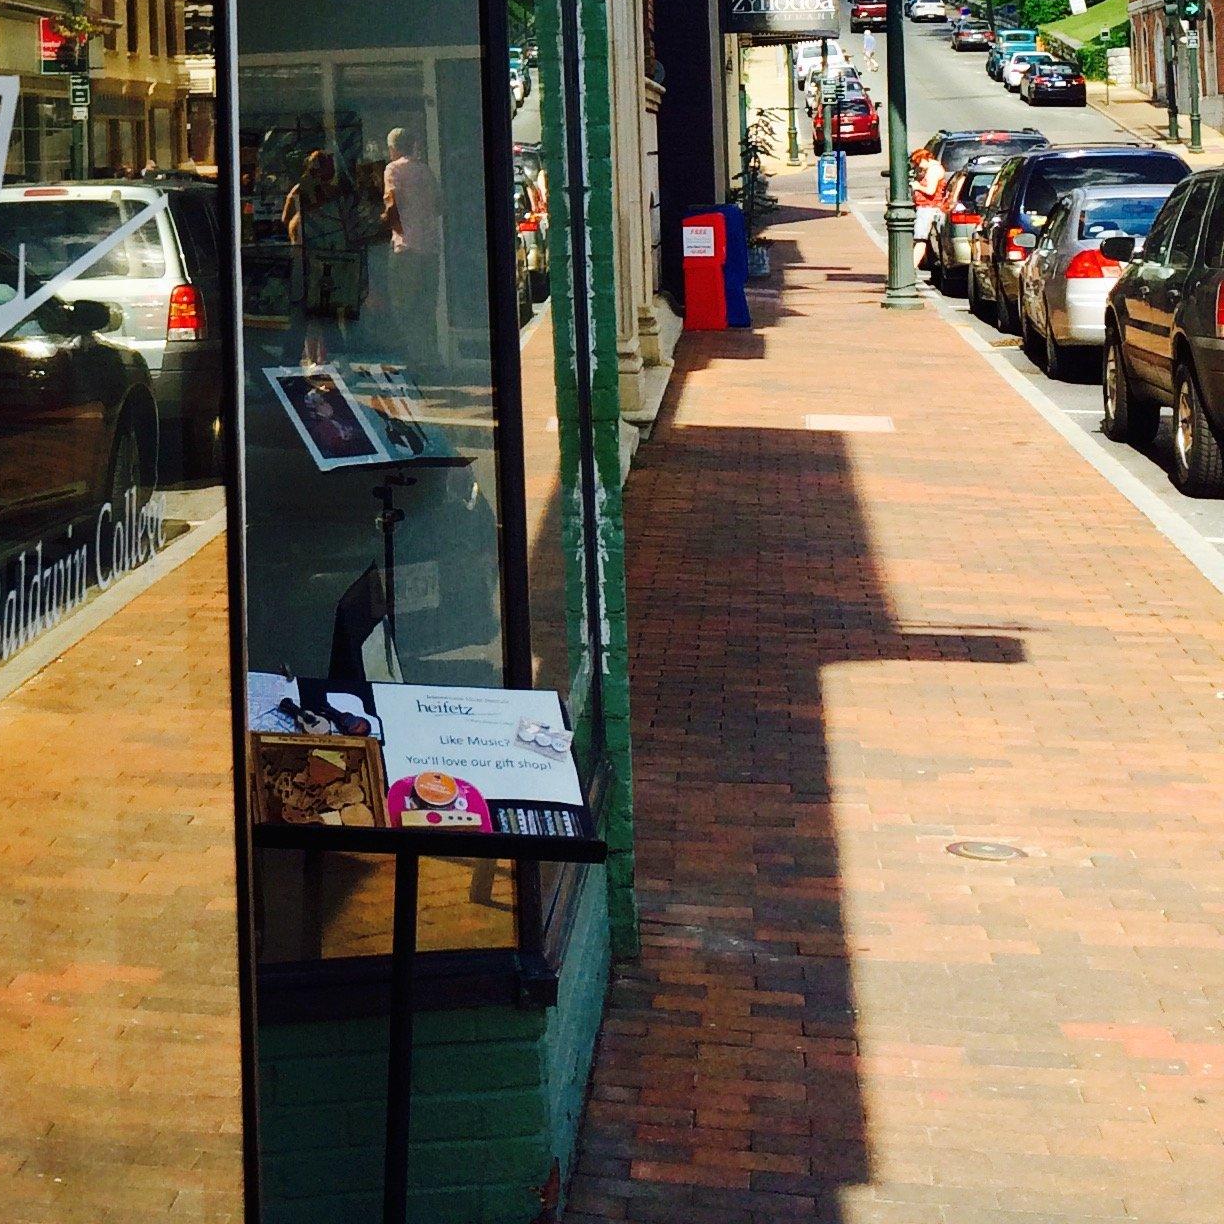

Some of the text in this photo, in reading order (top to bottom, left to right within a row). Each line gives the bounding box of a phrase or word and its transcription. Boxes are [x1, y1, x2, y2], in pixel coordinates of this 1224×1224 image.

[96, 485, 167, 588] College
[416, 699, 473, 715] heifetz
[440, 735, 510, 747] Like Music?
[406, 755, 552, 771] You'll love our gift shop!
